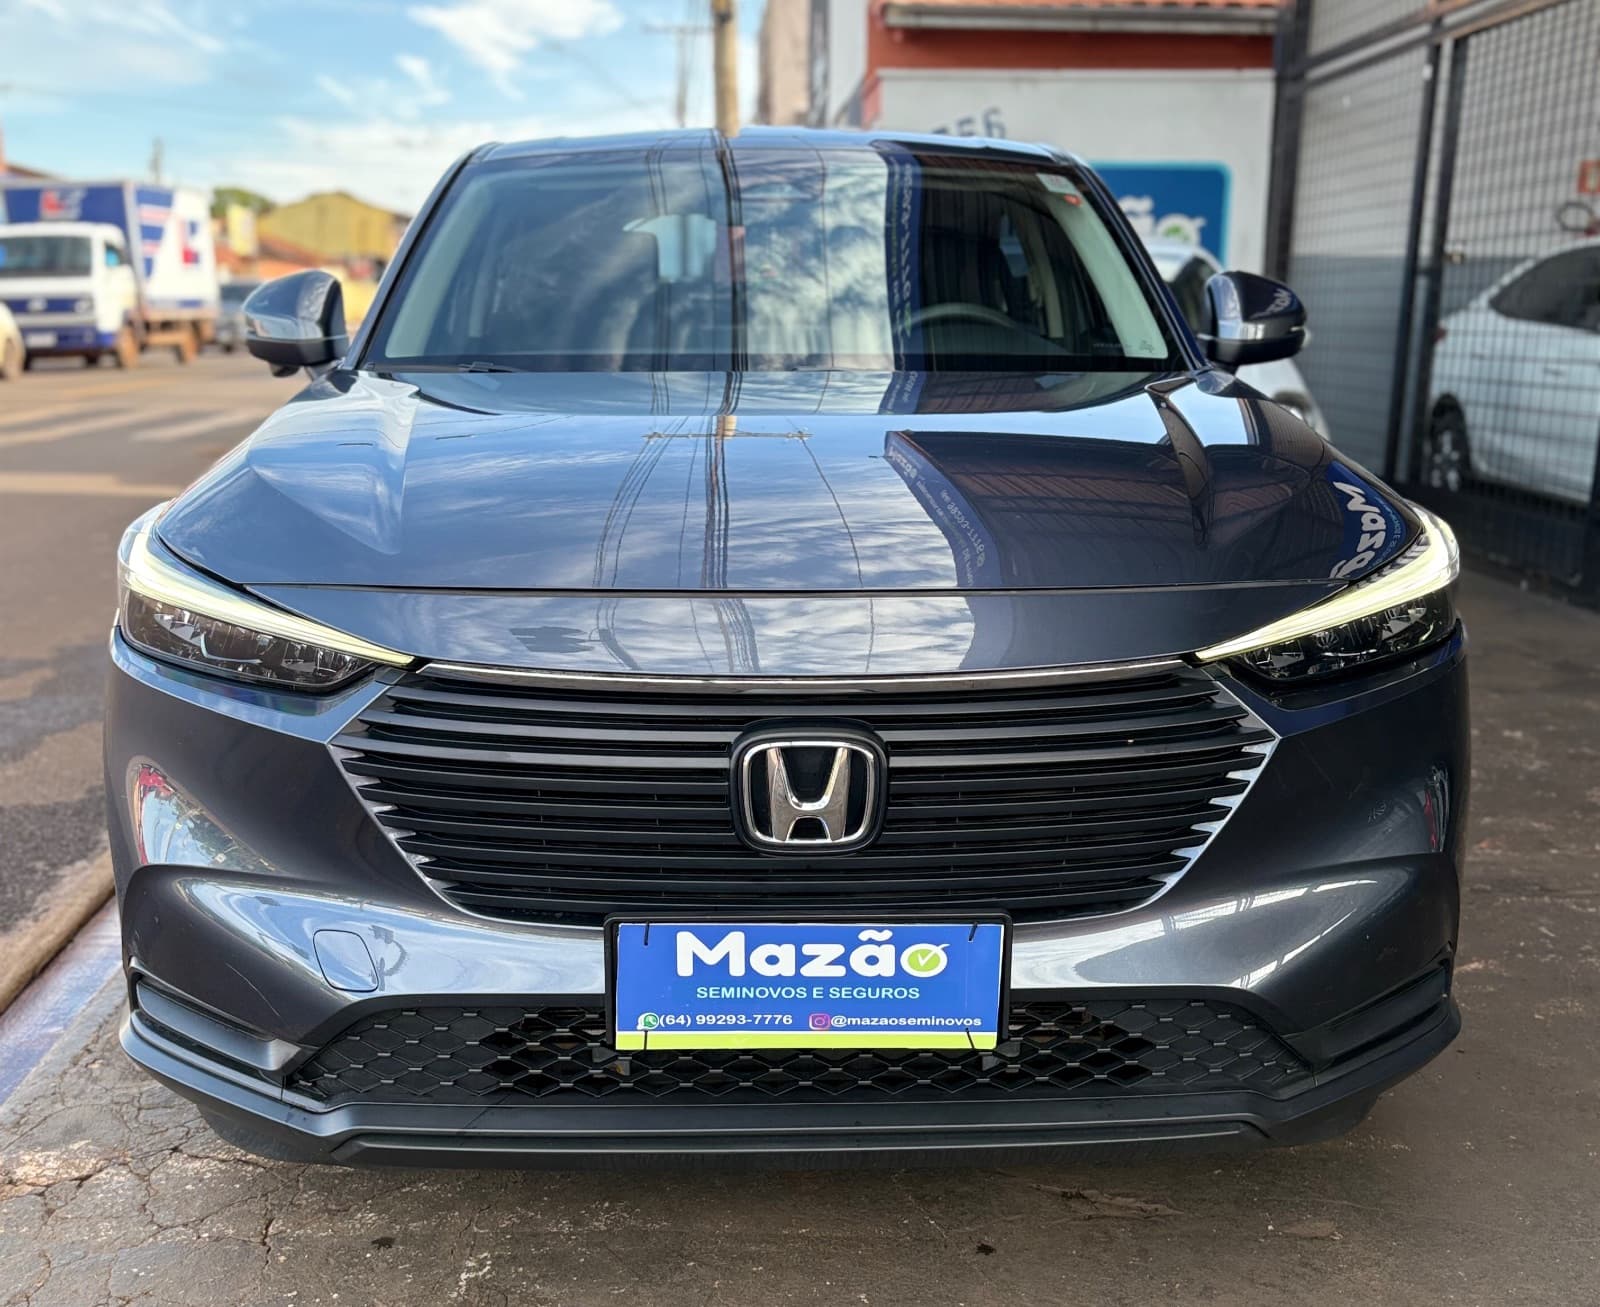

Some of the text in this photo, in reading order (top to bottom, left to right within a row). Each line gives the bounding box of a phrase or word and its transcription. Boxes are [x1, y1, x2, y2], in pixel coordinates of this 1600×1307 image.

[676, 929, 950, 978] Mazão
[696, 986, 920, 1000] SEMINOVOS E SEGUROS
[659, 1014, 793, 1028] (64) 99293-7776
[831, 1015, 982, 1028] @mazaoseminovos
